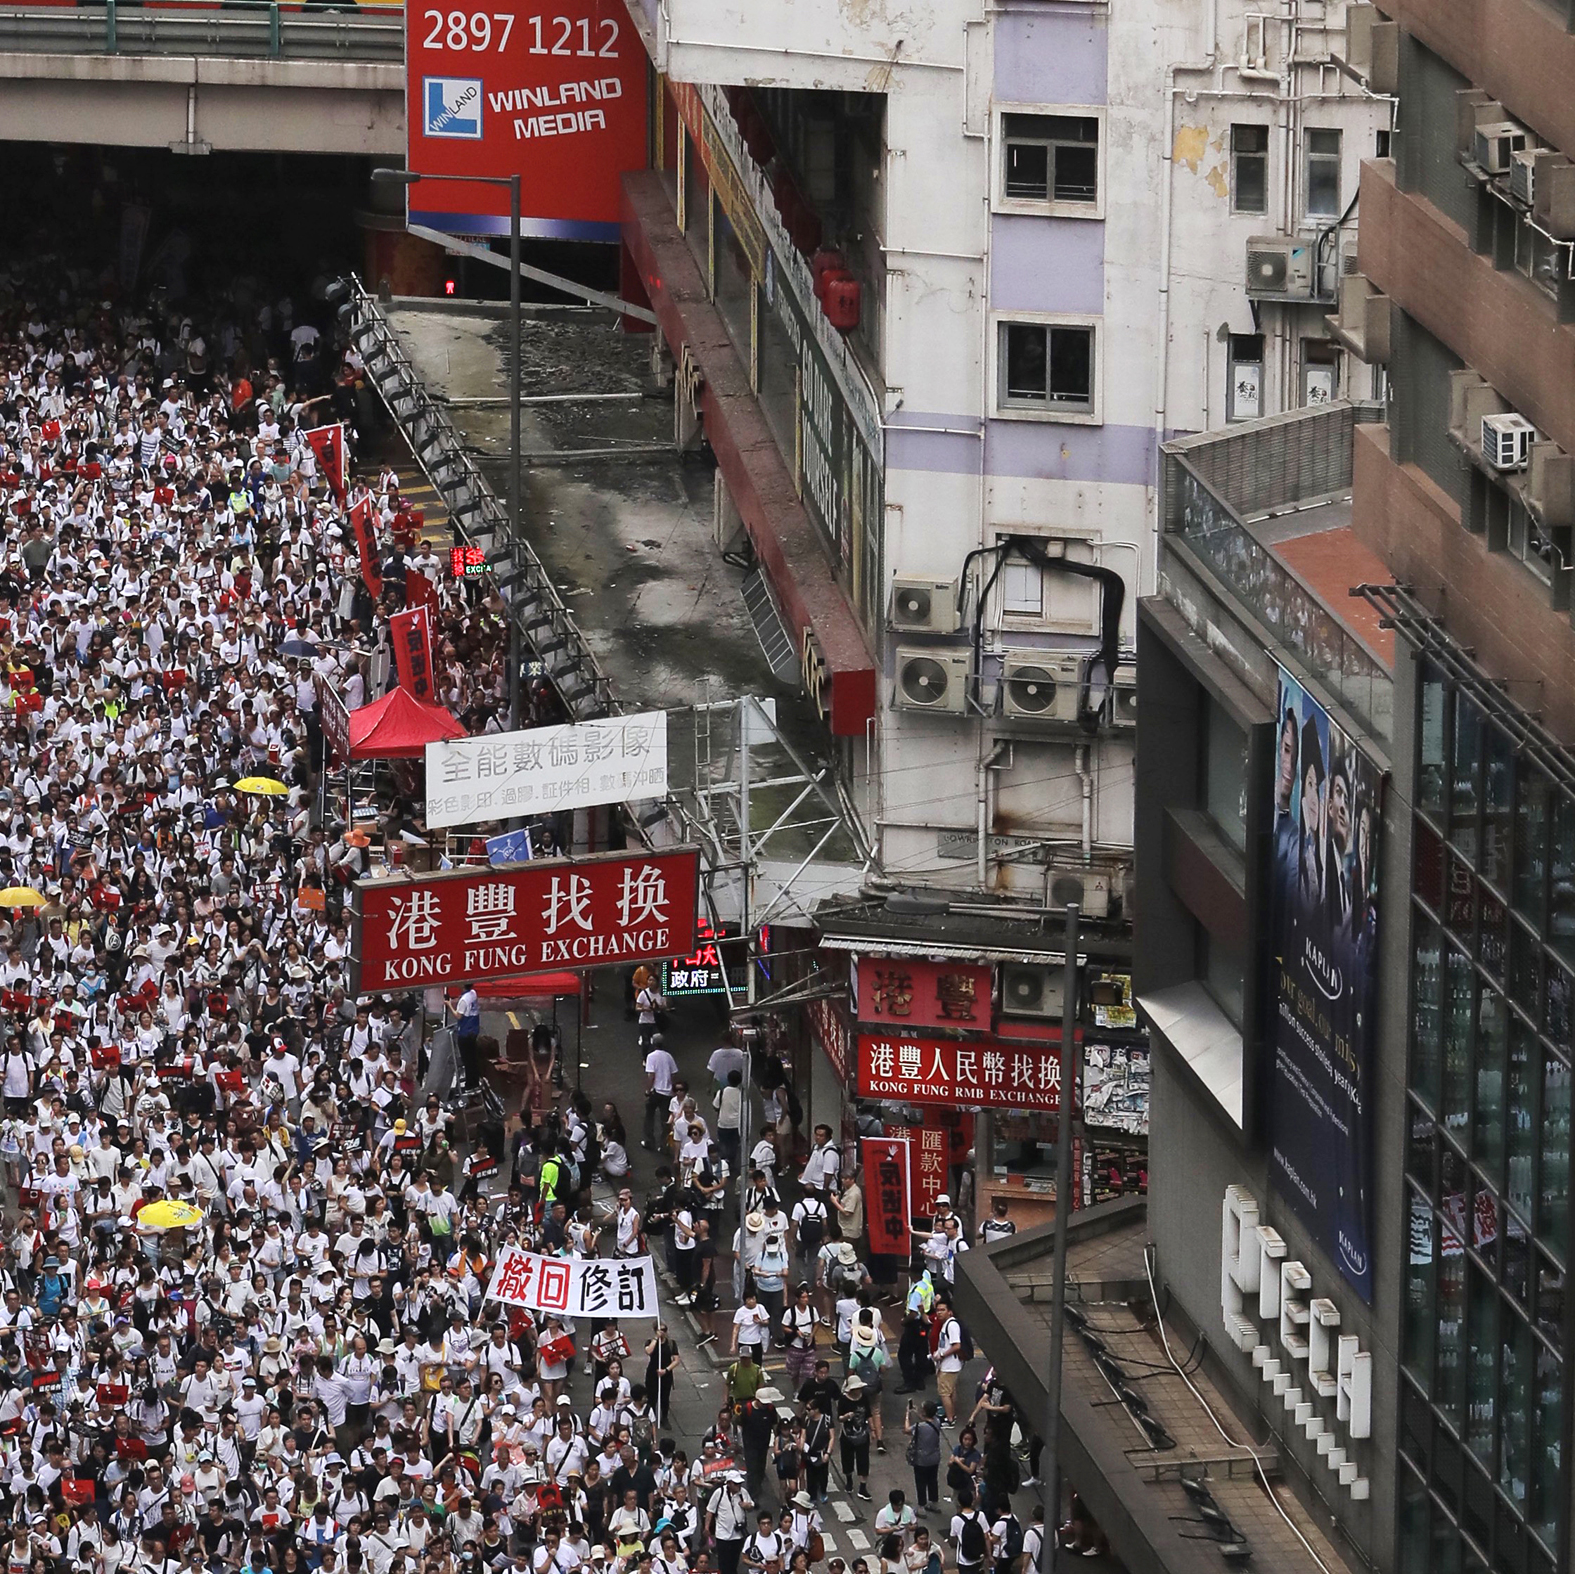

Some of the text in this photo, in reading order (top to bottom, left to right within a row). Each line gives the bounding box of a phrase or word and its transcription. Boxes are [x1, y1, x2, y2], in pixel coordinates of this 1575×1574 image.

[424, 10, 619, 59] 2897 1212
[430, 85, 477, 133] WINLAND
[488, 78, 623, 114] WINLAND
[514, 109, 606, 140] MEDIA
[441, 725, 651, 784] 全能數碼影像
[386, 865, 671, 952] 港豐找換
[384, 952, 452, 982] KONG
[463, 944, 526, 972] FUNG
[540, 927, 670, 961] EXCHANGE
[1305, 936, 1339, 991] KAPLAN
[869, 1044, 1062, 1091] 港豐人民幣找換
[869, 1080, 1062, 1105] KONG FUNG RMB EXCHANGE
[921, 1130, 944, 1218] 匯款中心
[1339, 1229, 1364, 1272] KAPLAN
[496, 1253, 646, 1312] 撤回修訂
